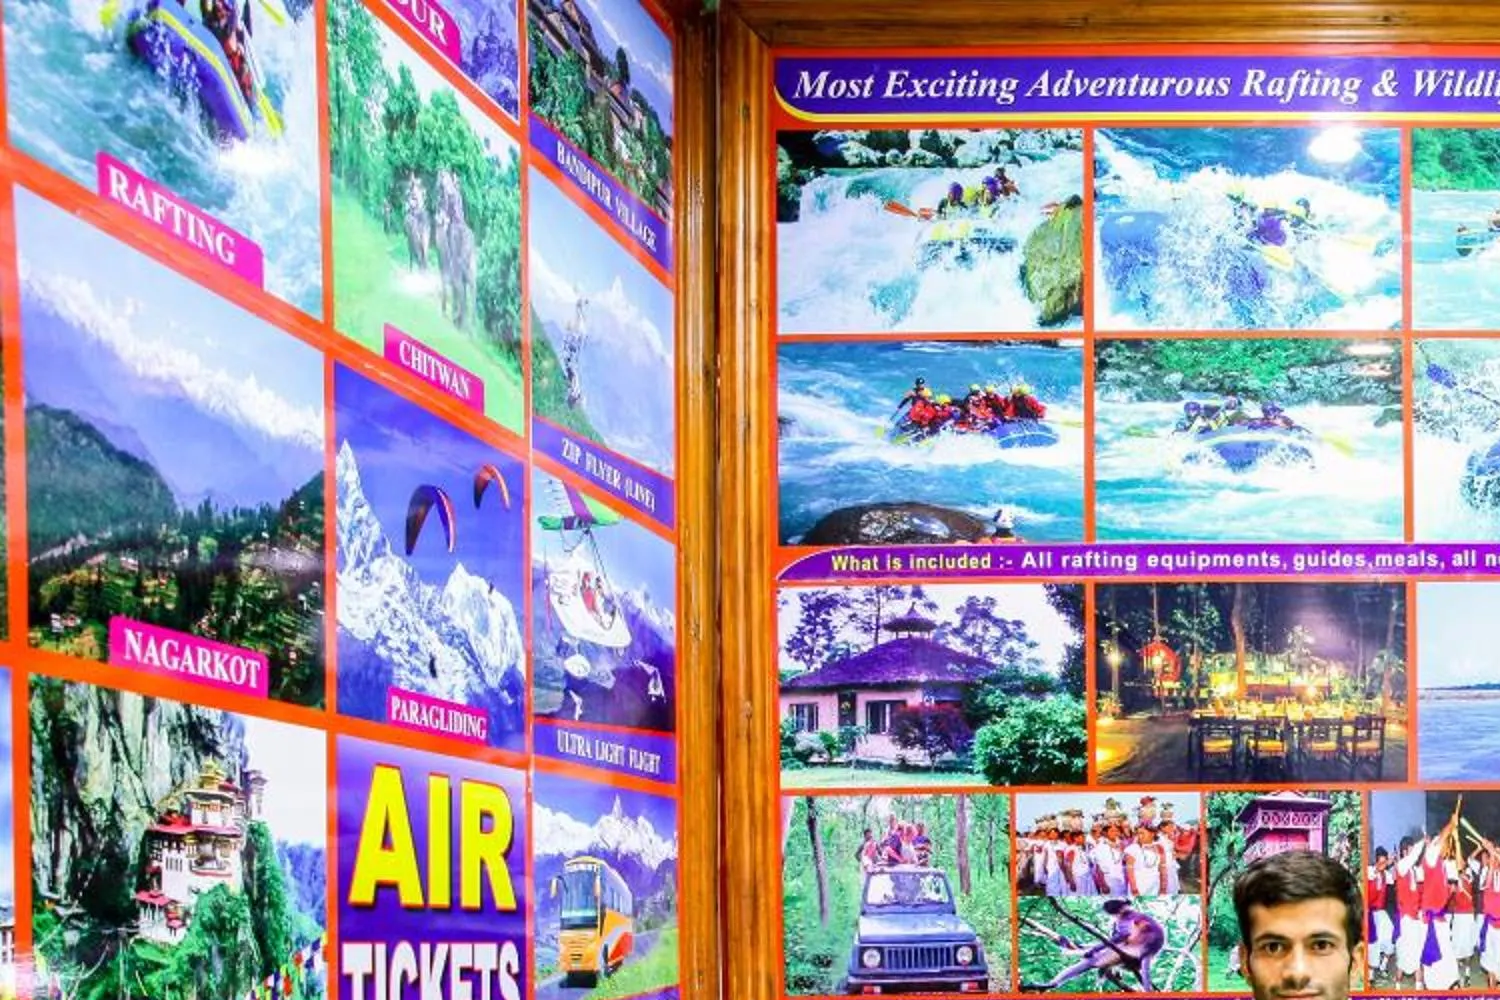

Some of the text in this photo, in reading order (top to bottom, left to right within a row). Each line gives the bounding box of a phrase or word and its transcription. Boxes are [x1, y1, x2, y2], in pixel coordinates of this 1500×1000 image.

[397, 0, 447, 45] UR
[793, 69, 873, 100] Most
[884, 70, 1017, 105] Exciting
[1025, 68, 1232, 99] Adventurous
[1240, 68, 1362, 106] Rafting
[1372, 69, 1400, 98] &
[108, 163, 235, 266] RAFTING
[399, 339, 470, 401] CHITWAN
[831, 554, 880, 572] What
[885, 553, 903, 571] is
[909, 553, 992, 570] included
[1021, 551, 1053, 569] All
[1061, 551, 1138, 572] rafting
[1147, 550, 1288, 573] equipments,
[1452, 550, 1477, 568] all
[123, 628, 261, 688] NAGARKOT
[391, 695, 487, 740] PARAGLIDING
[349, 763, 517, 912] AIR
